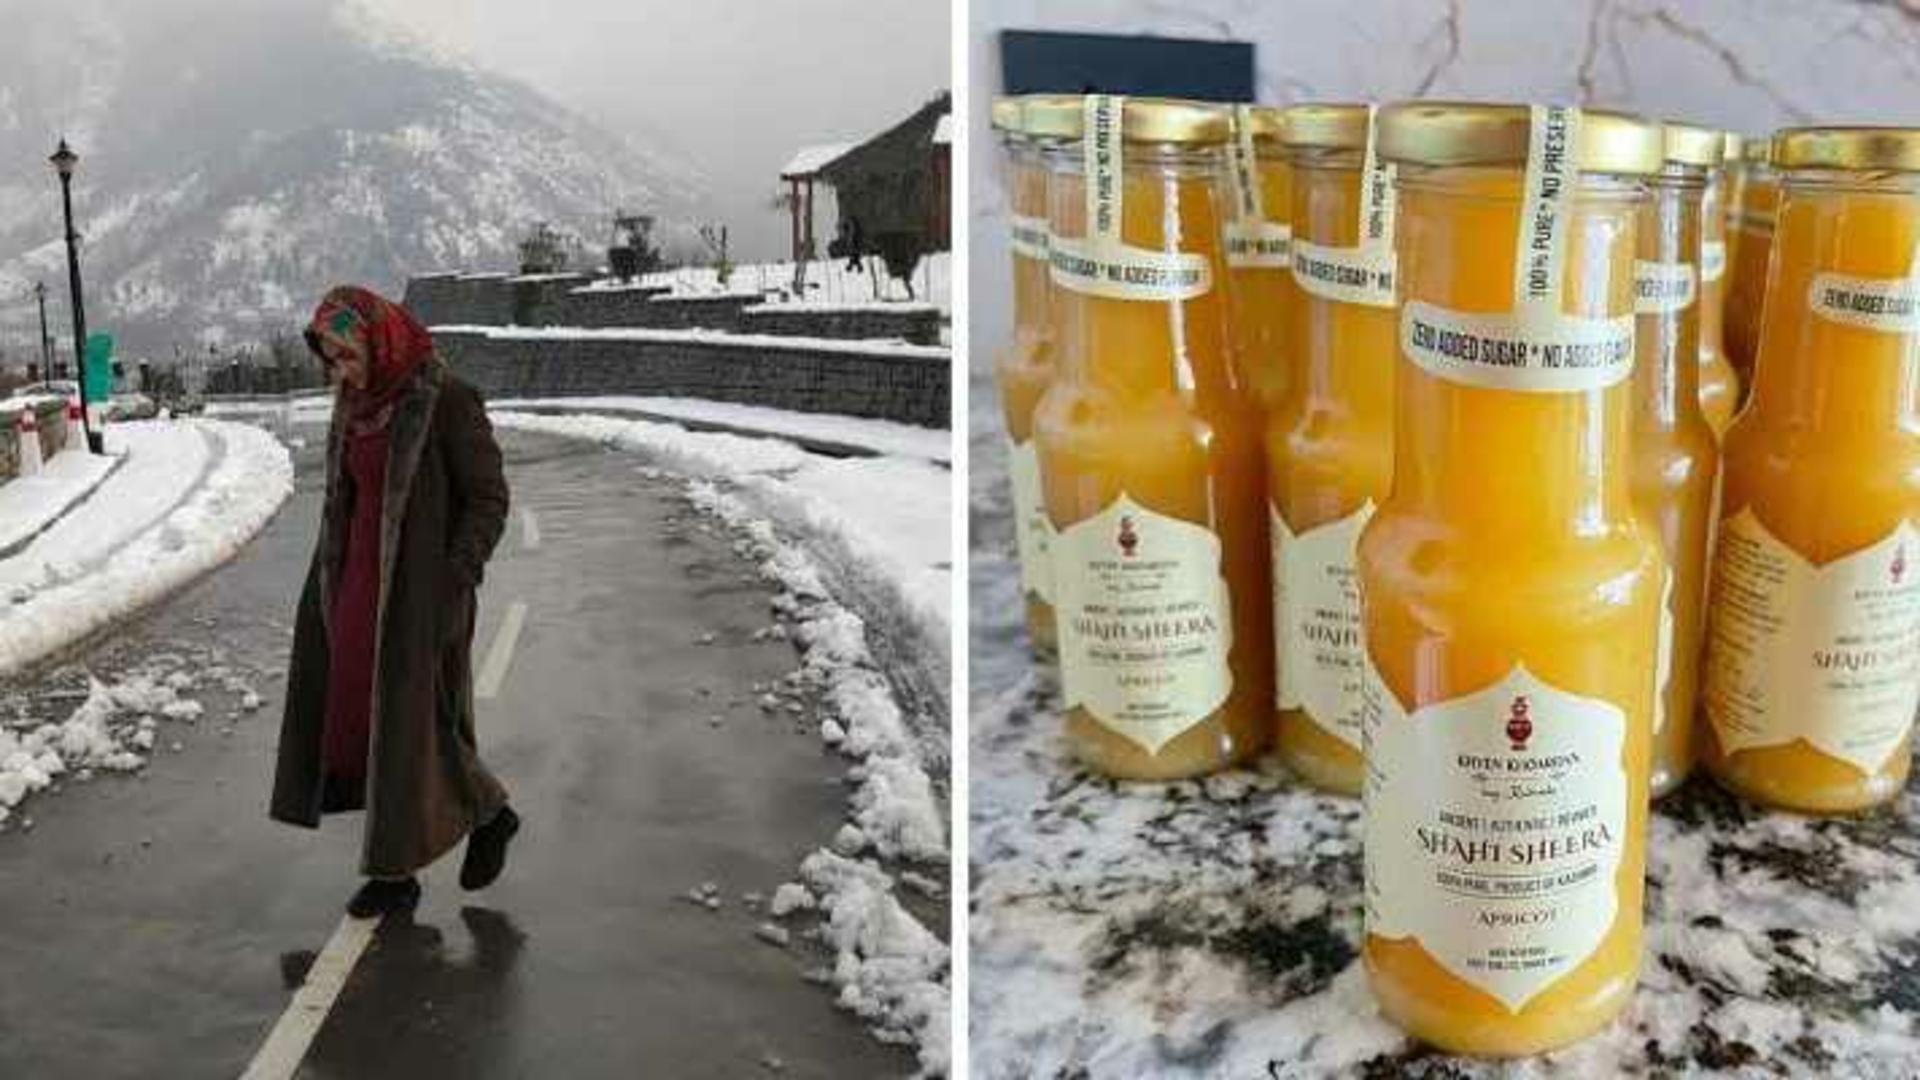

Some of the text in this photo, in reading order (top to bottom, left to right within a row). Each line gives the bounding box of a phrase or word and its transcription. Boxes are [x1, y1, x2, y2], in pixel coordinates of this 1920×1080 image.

[1527, 255, 1549, 297] 100%
[1539, 177, 1561, 200] NO
[1412, 320, 1436, 350] ZERO
[1437, 330, 1479, 362] ADDED
[1480, 338, 1528, 369] SUGAR
[1541, 344, 1562, 368] NO
[1509, 822, 1612, 865] SHEERA
